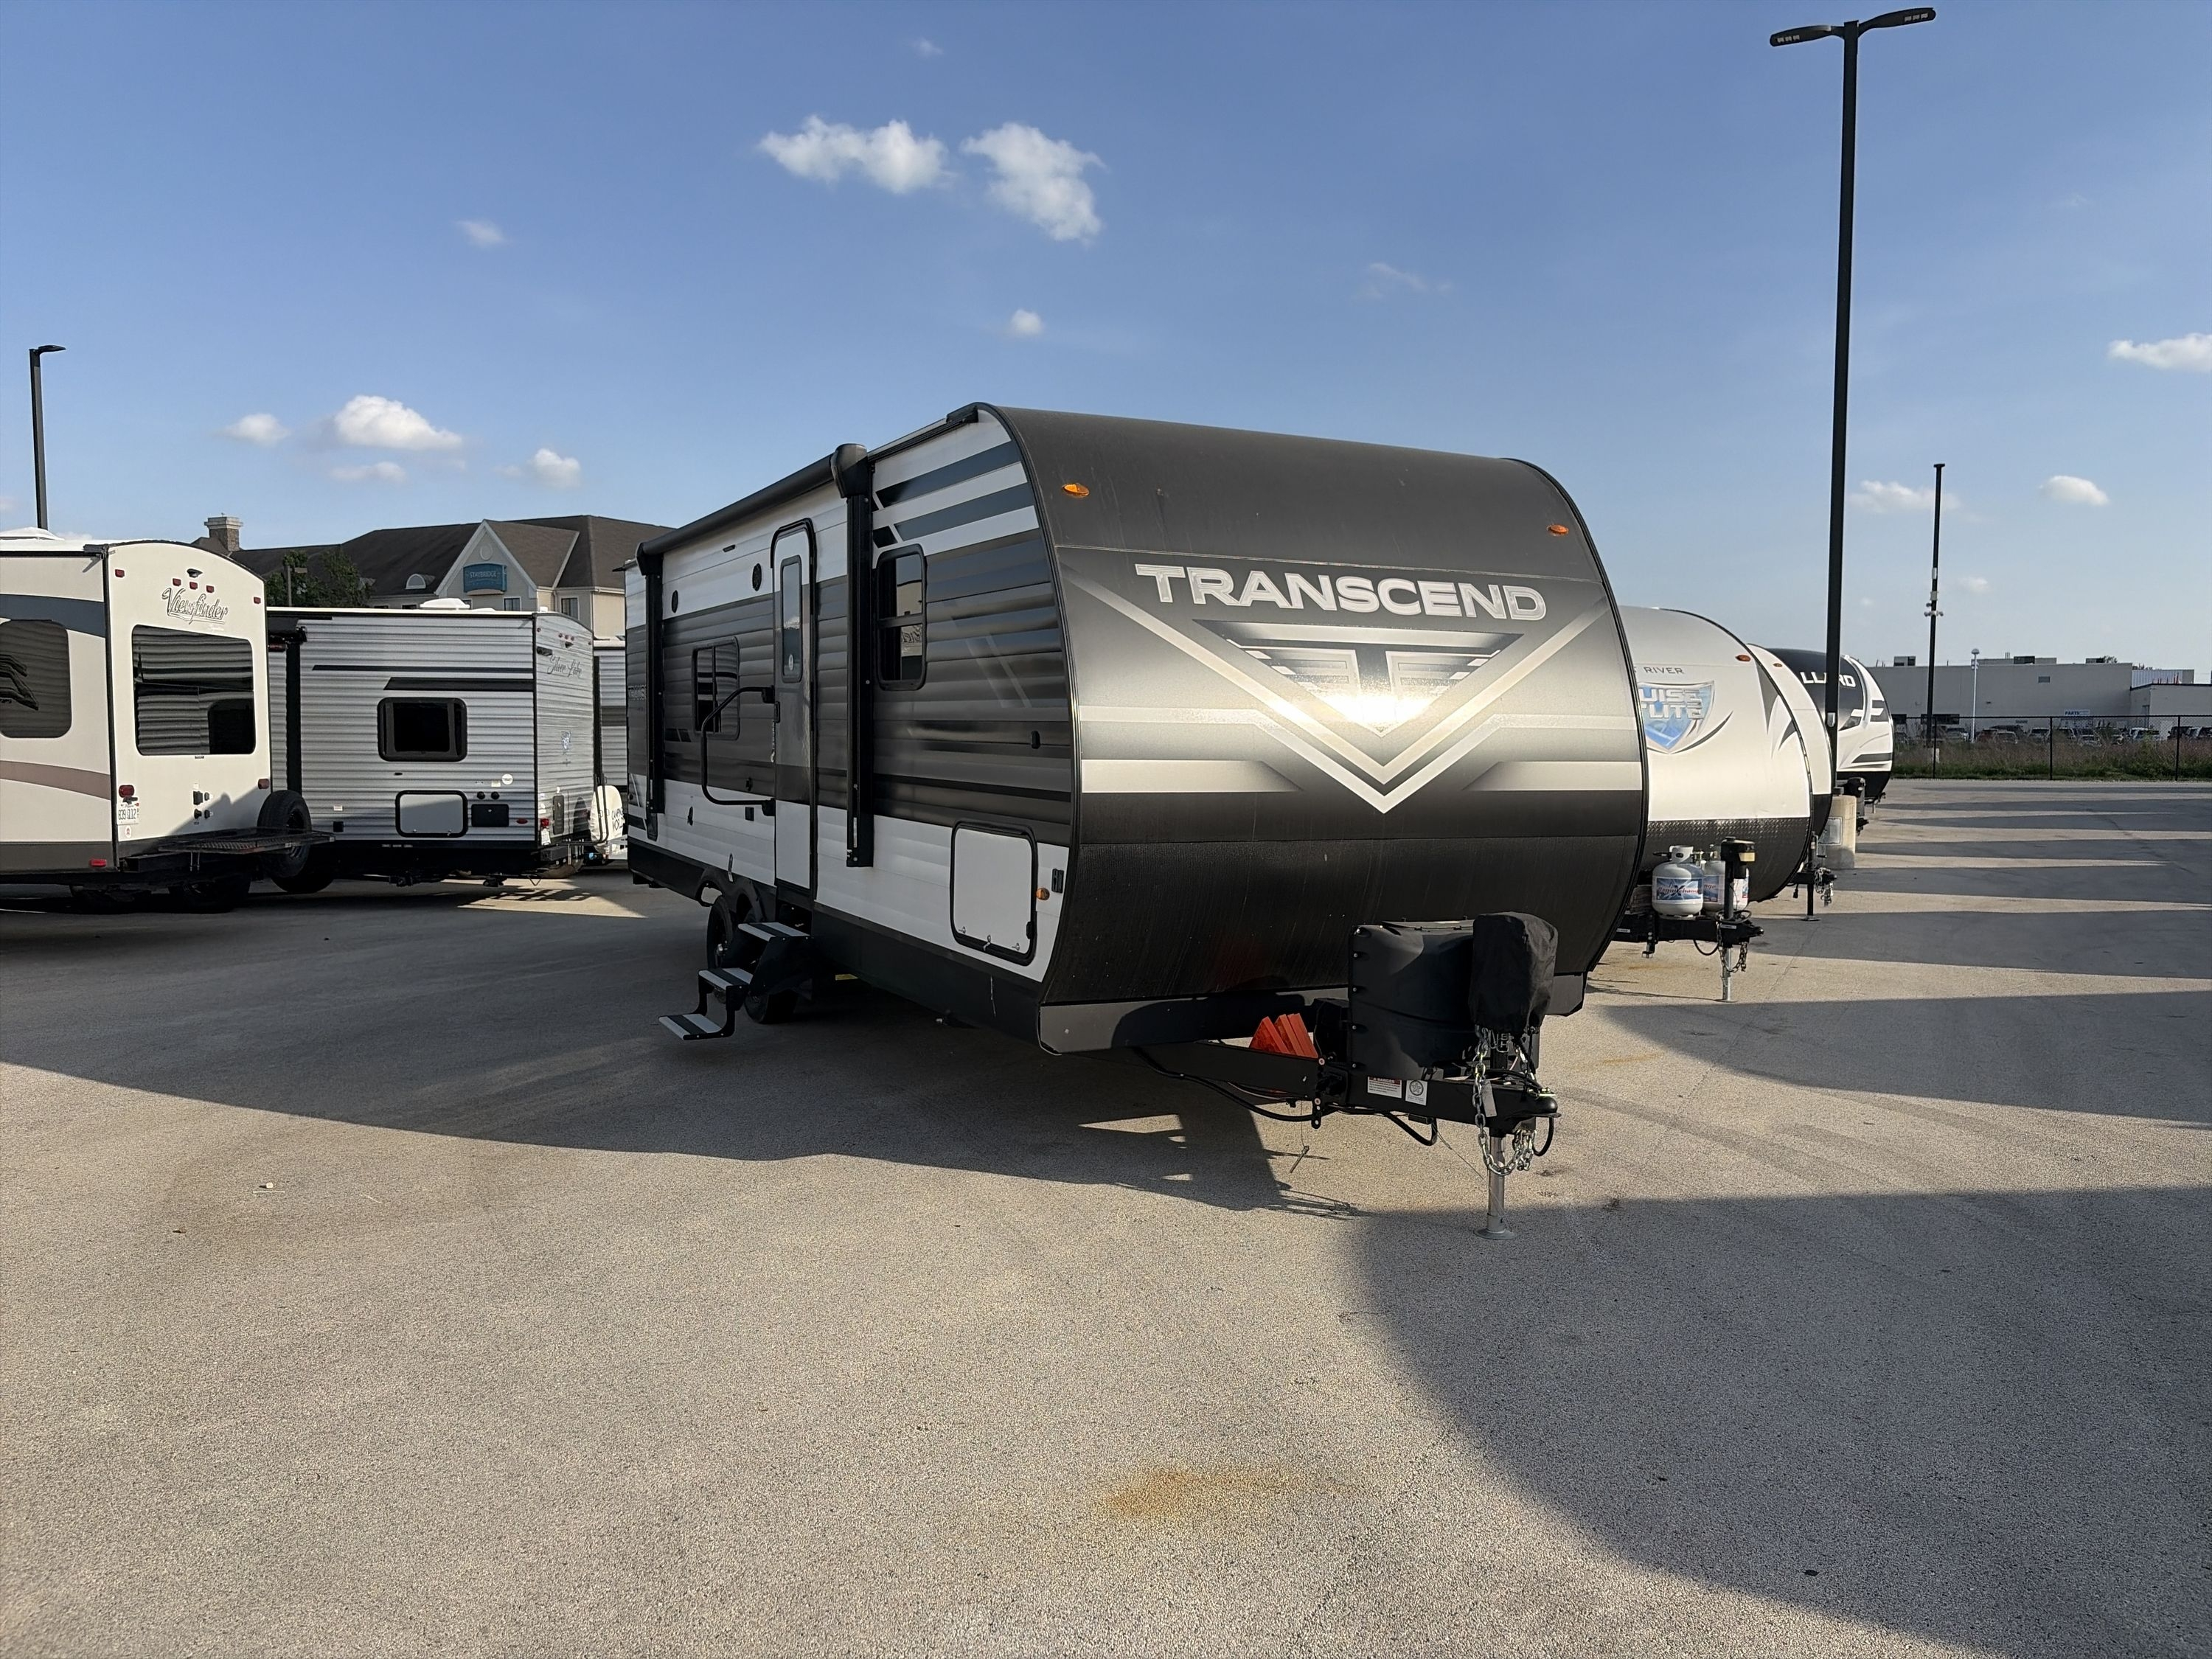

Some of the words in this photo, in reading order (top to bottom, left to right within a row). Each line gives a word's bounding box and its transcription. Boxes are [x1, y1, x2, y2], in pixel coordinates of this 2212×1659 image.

[1135, 563, 1547, 621] TRANSCEND
[161, 587, 229, 625] Viewfinder
[1800, 672, 1856, 687] LLRD
[1641, 702, 1704, 719] LITE
